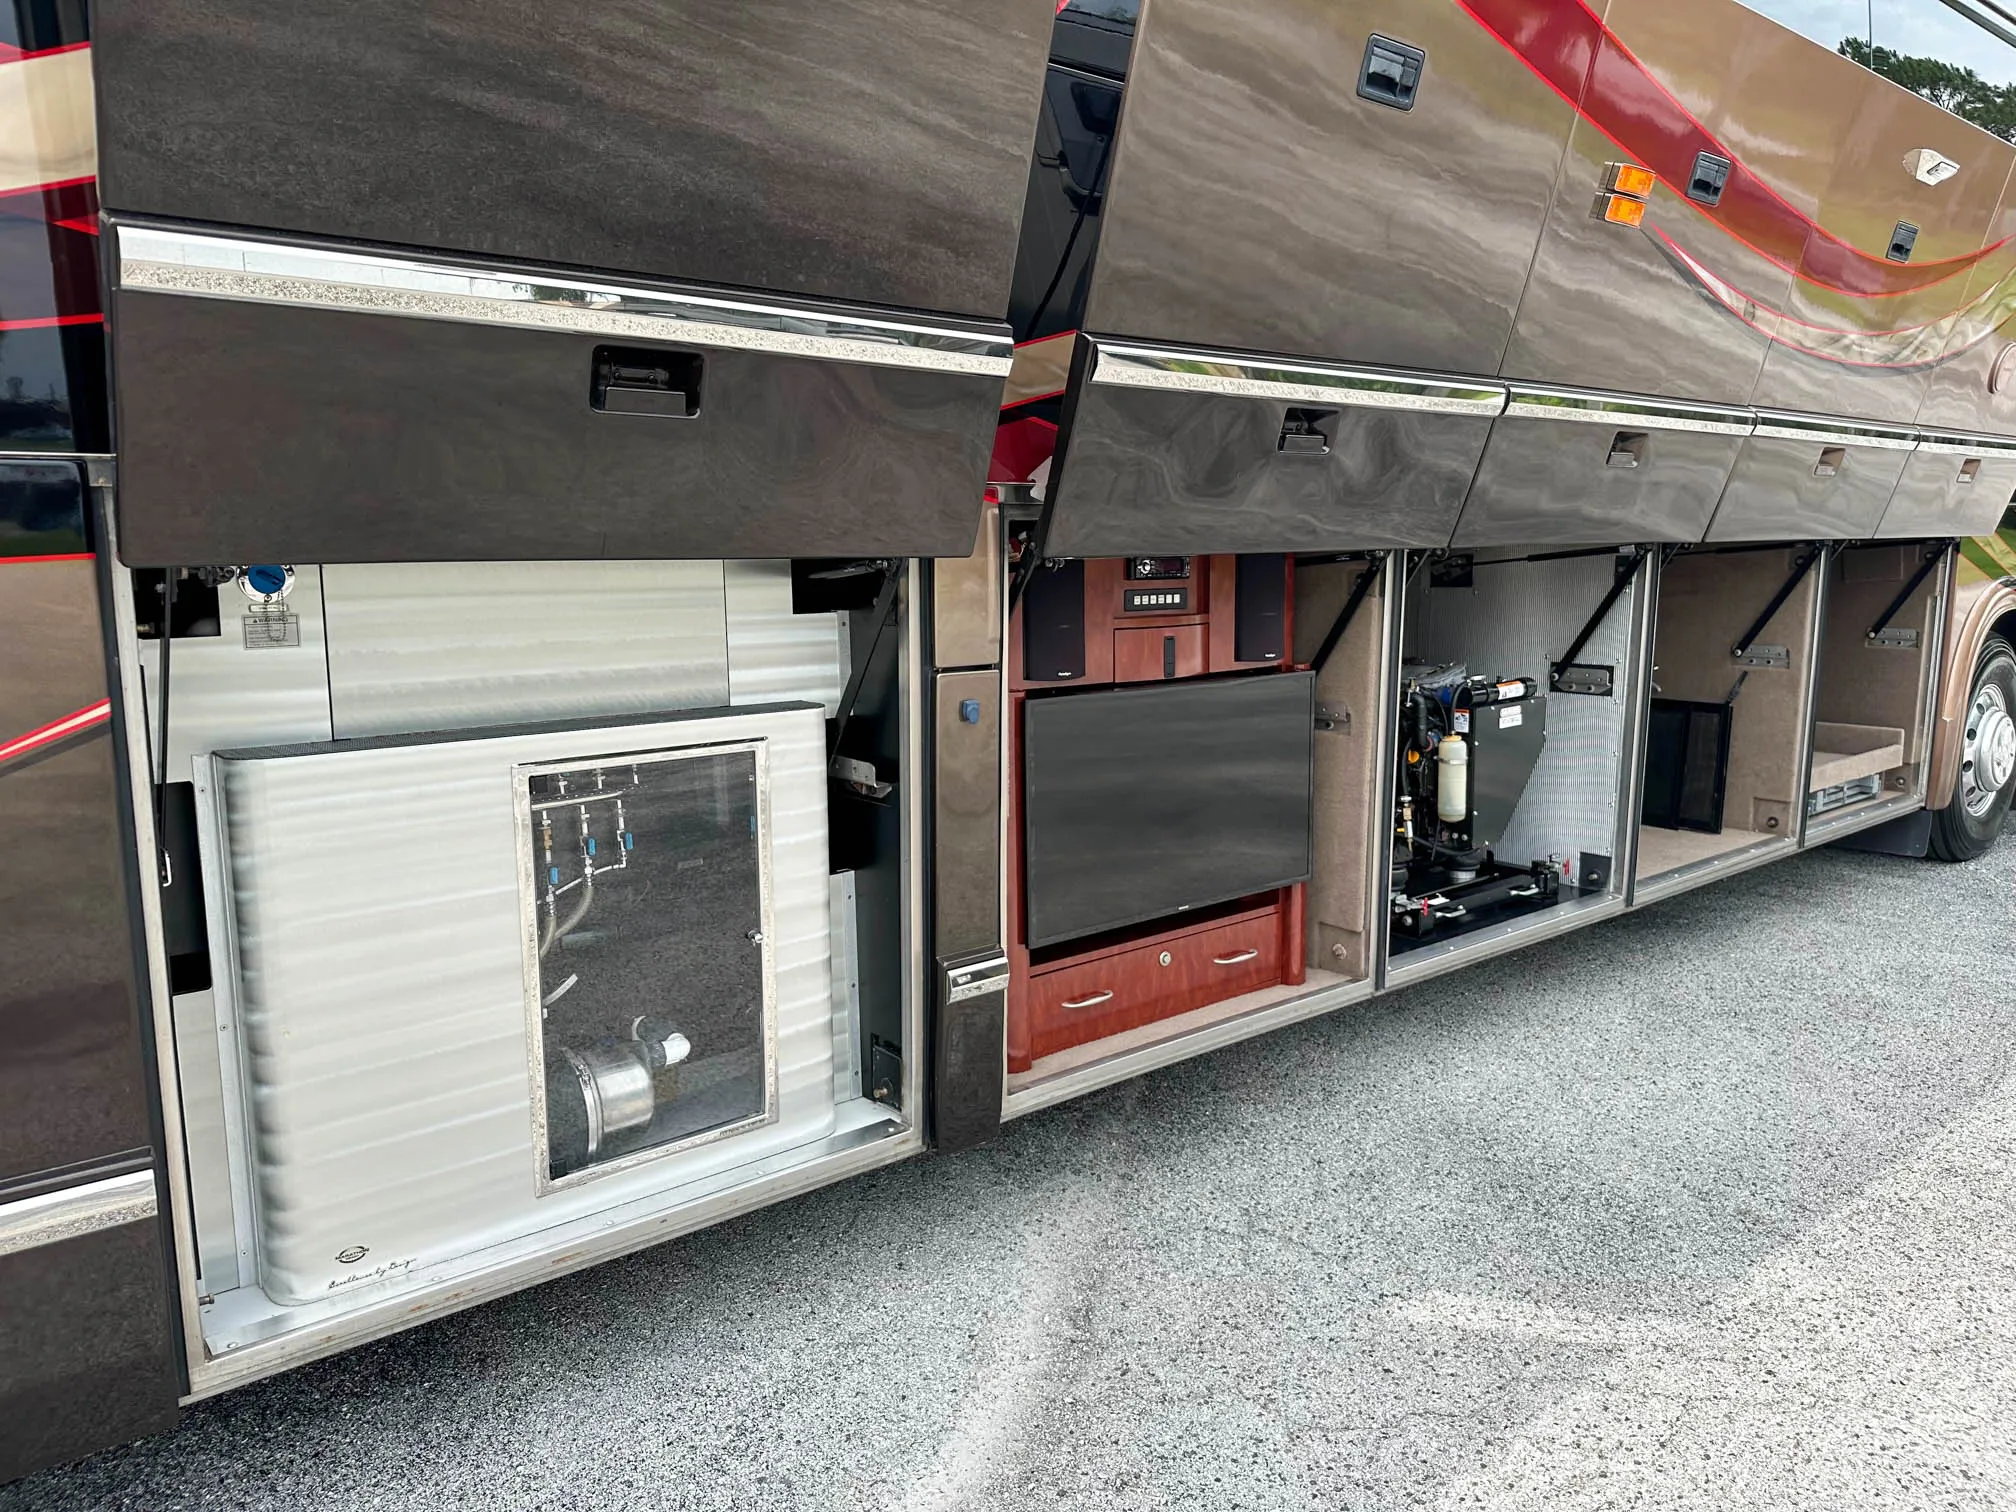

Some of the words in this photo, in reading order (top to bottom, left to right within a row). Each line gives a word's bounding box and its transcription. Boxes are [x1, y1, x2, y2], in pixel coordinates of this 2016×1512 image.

[335, 1247, 370, 1260] MARATHON
[328, 1273, 373, 1289] Excellence
[375, 1266, 387, 1278] by
[388, 1257, 417, 1270] Design
